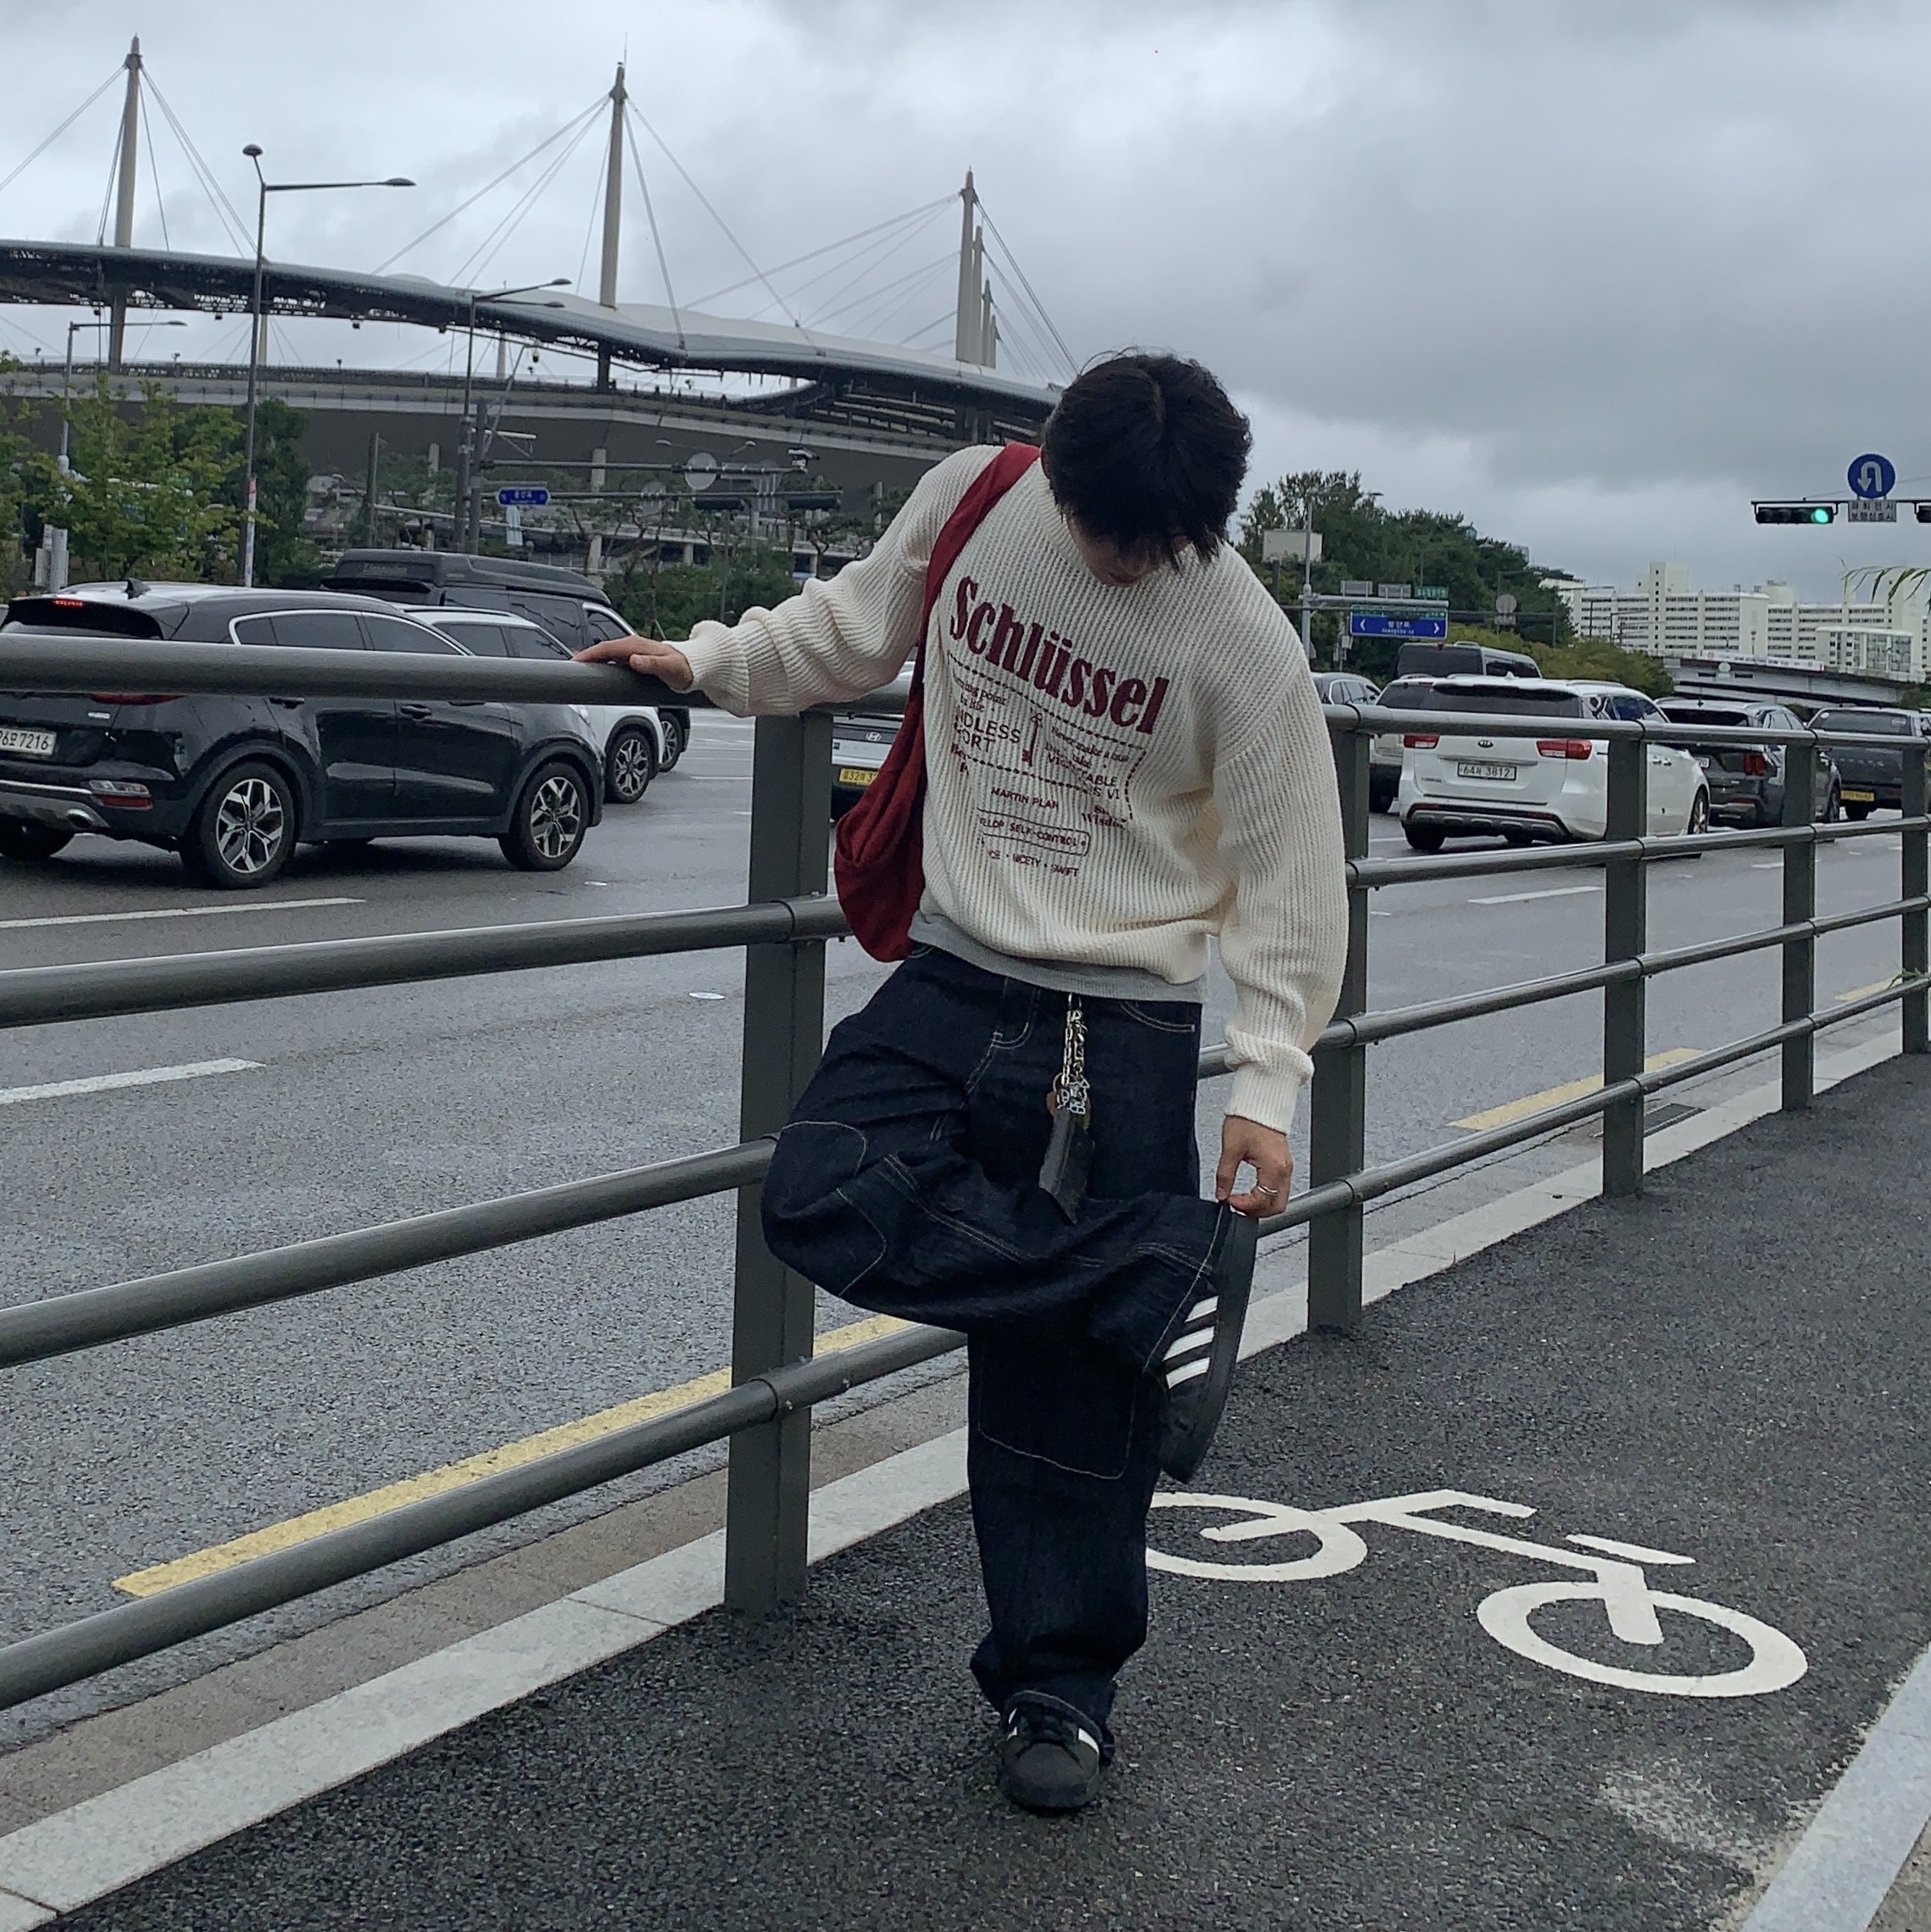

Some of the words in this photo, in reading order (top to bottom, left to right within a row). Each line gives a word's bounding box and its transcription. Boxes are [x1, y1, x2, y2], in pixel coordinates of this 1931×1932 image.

[950, 576, 1170, 734] Schlüssel
[19, 732, 49, 751] 7216
[991, 787, 1029, 804] MARTIN
[1010, 821, 1077, 847] SELF-CONTROL
